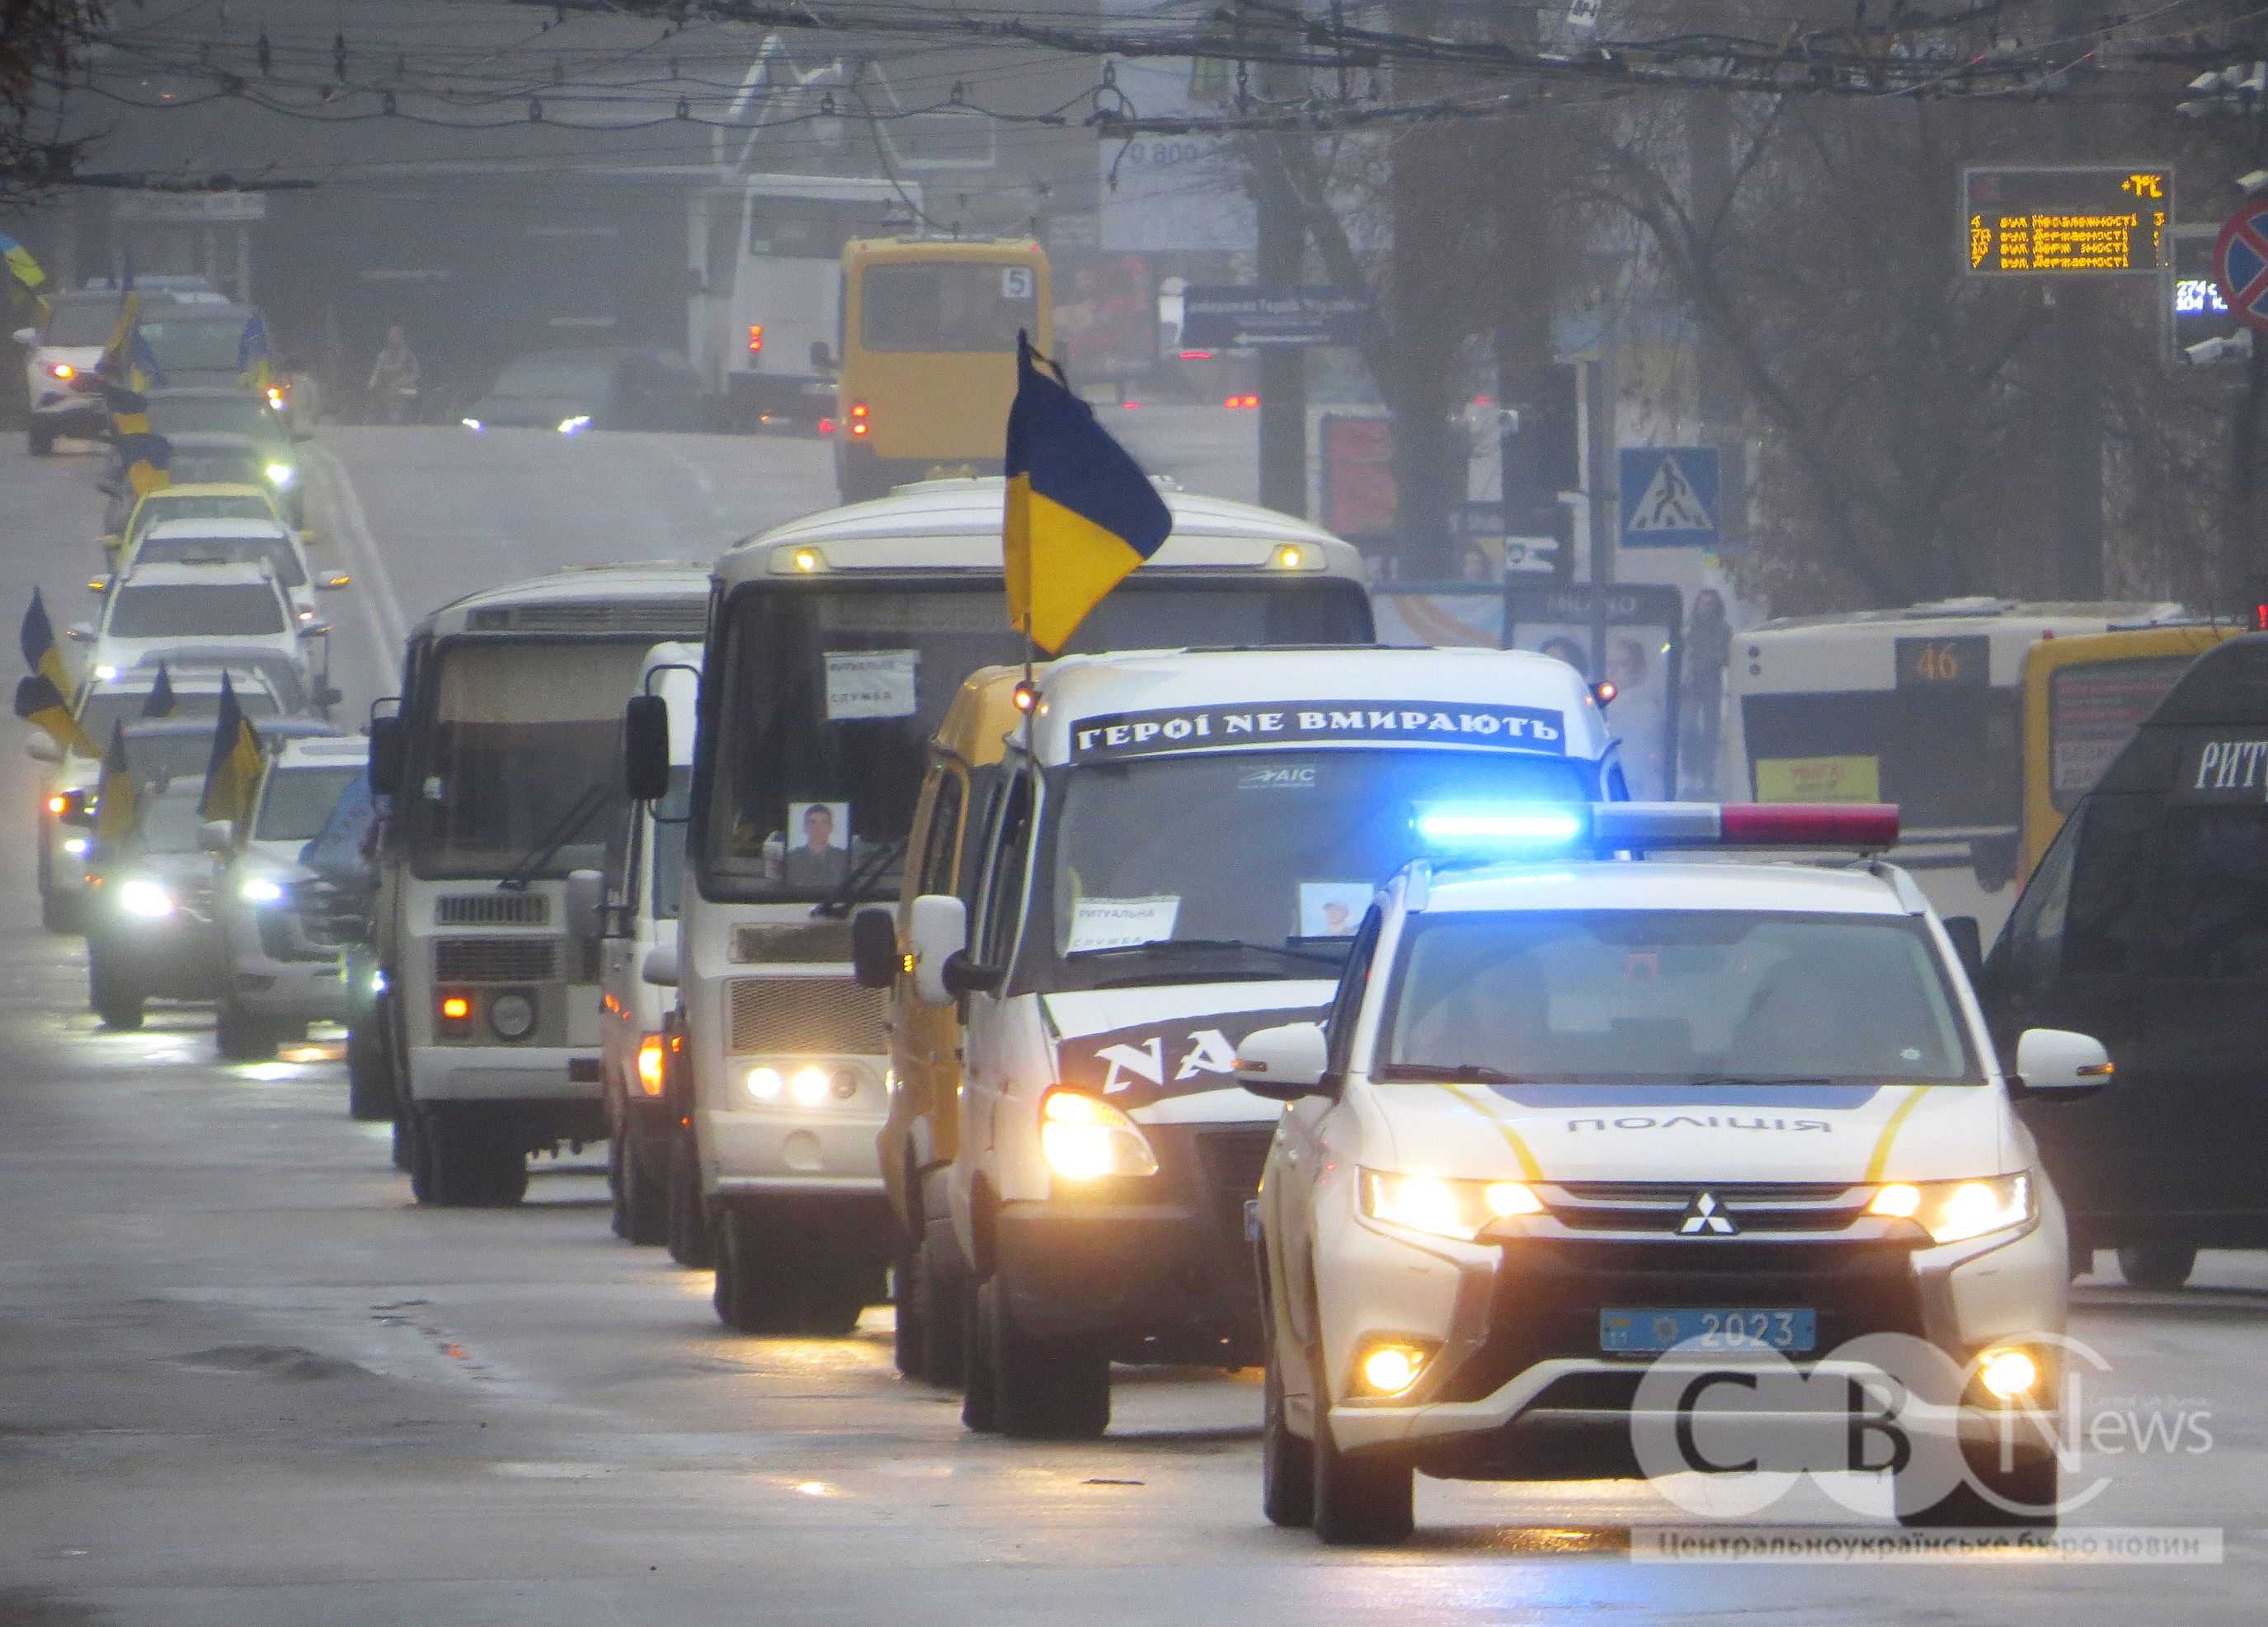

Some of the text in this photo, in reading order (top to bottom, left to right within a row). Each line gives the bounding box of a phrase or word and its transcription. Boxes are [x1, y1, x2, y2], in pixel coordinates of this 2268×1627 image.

[1917, 642, 1960, 680] 46
[1296, 710, 1560, 741] ВМИРАЮТЬ
[1275, 769, 1317, 782] AIC
[1568, 1116, 1832, 1133] ПОЛІЦІЯ
[1701, 1312, 1795, 1347] 2023
